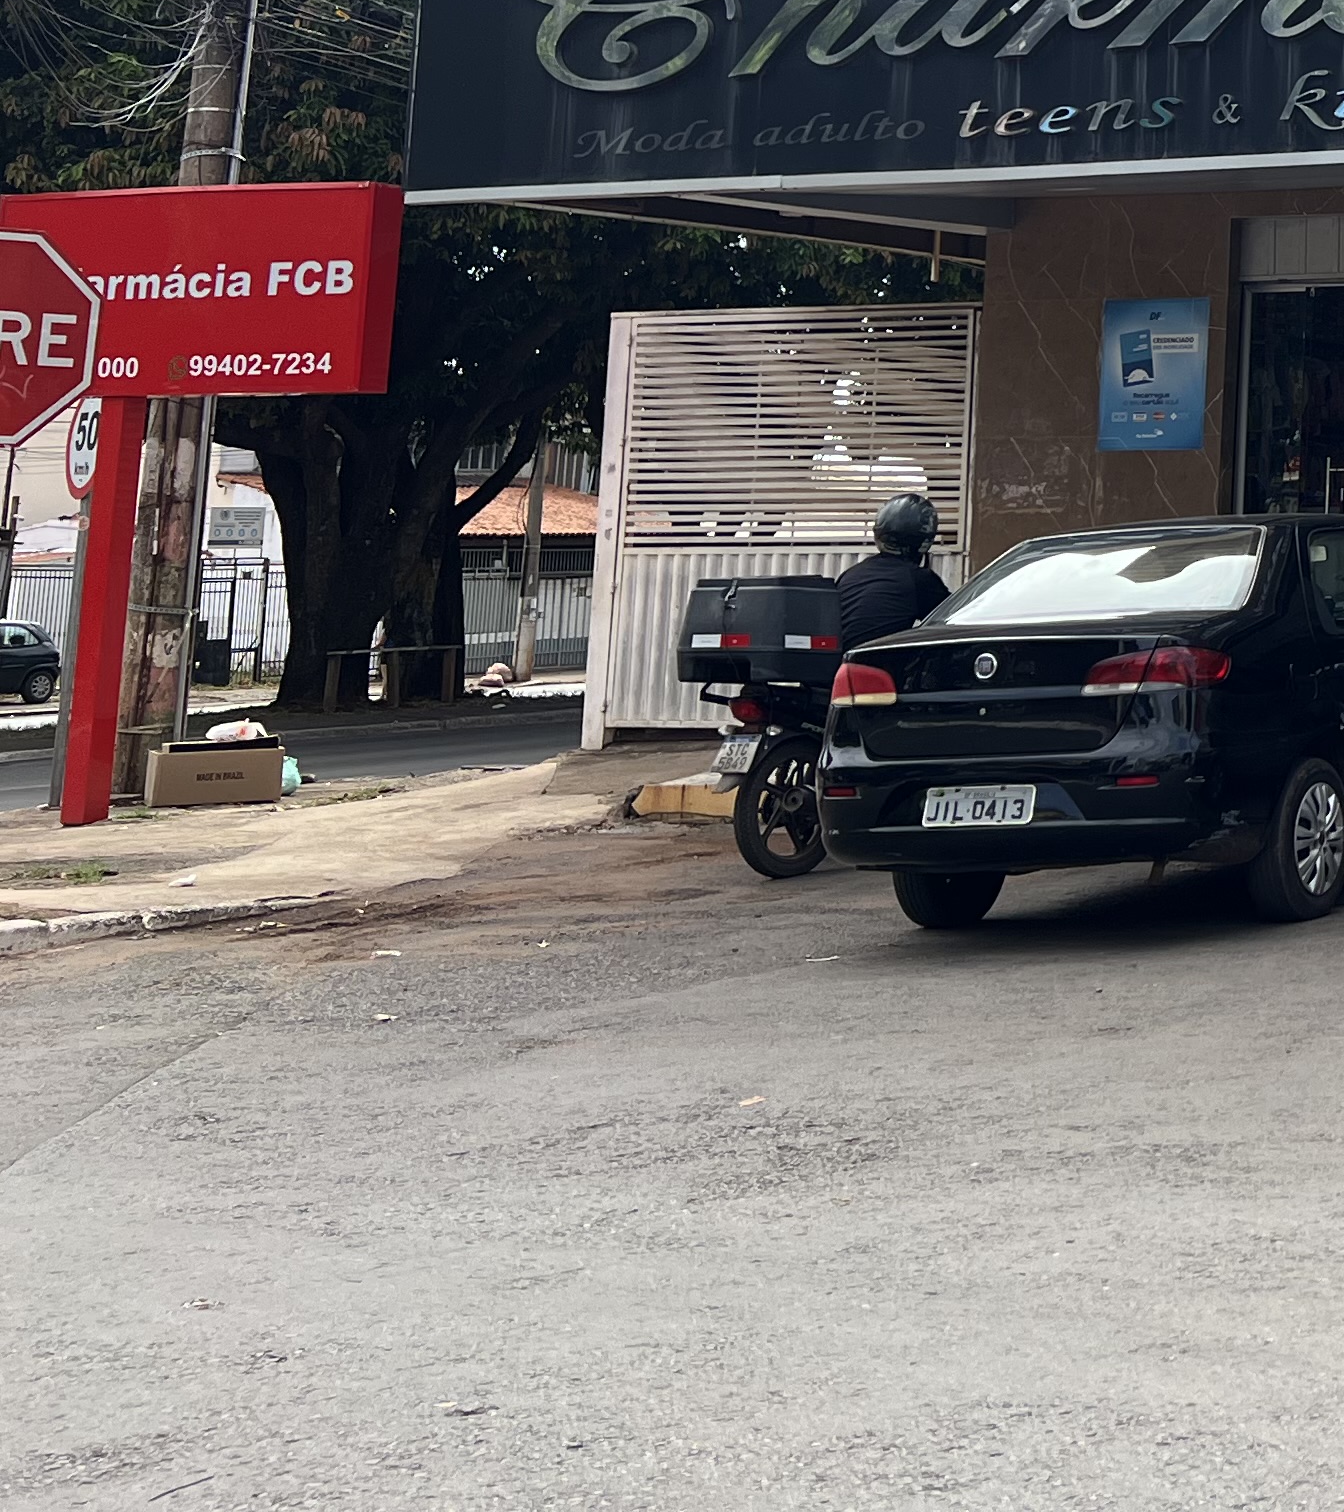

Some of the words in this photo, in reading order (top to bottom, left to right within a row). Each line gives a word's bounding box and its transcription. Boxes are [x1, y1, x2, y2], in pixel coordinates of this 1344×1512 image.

[575, 118, 731, 159] Moda
[751, 108, 927, 148] adulto
[958, 90, 1186, 141] teens
[1210, 93, 1242, 125] &
[77, 264, 251, 301] armácia
[266, 259, 354, 296] FCB
[0, 310, 77, 368] RE
[97, 357, 139, 379] 000
[188, 352, 332, 377] 99402-7234
[75, 410, 100, 451] 50
